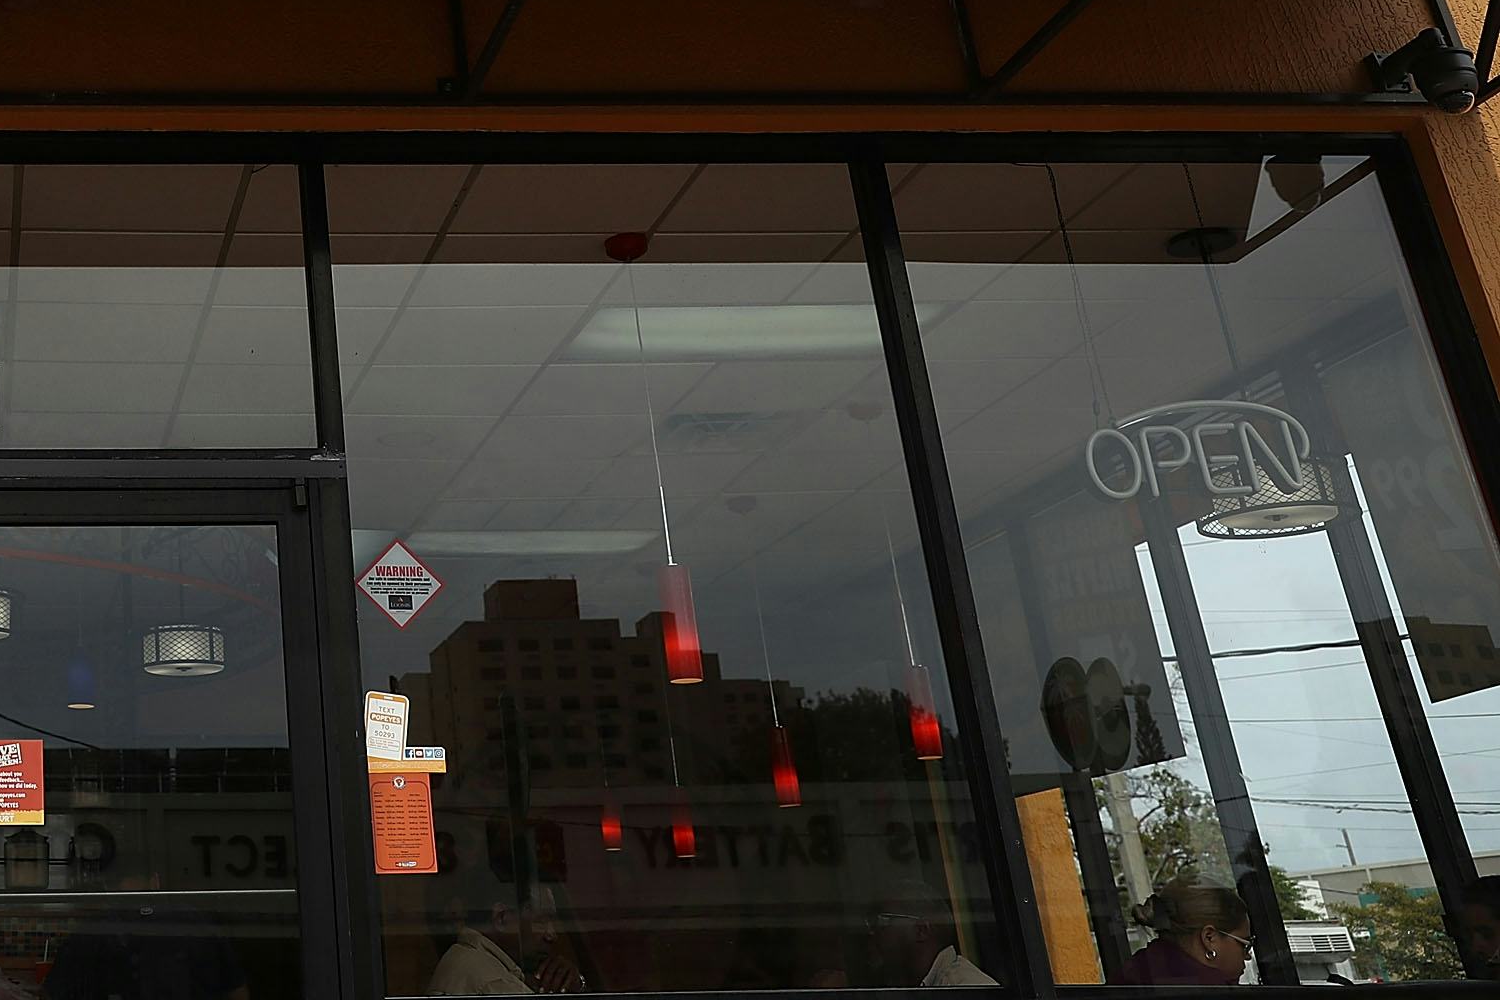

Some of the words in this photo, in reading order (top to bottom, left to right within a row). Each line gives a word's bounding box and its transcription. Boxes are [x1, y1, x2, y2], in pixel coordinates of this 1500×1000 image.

[1085, 421, 1304, 500] OPEN
[375, 565, 424, 577] WARNING
[378, 705, 396, 714] TEXT
[371, 713, 401, 724] POPEYES
[381, 723, 390, 731] TO
[374, 730, 396, 739] 50293
